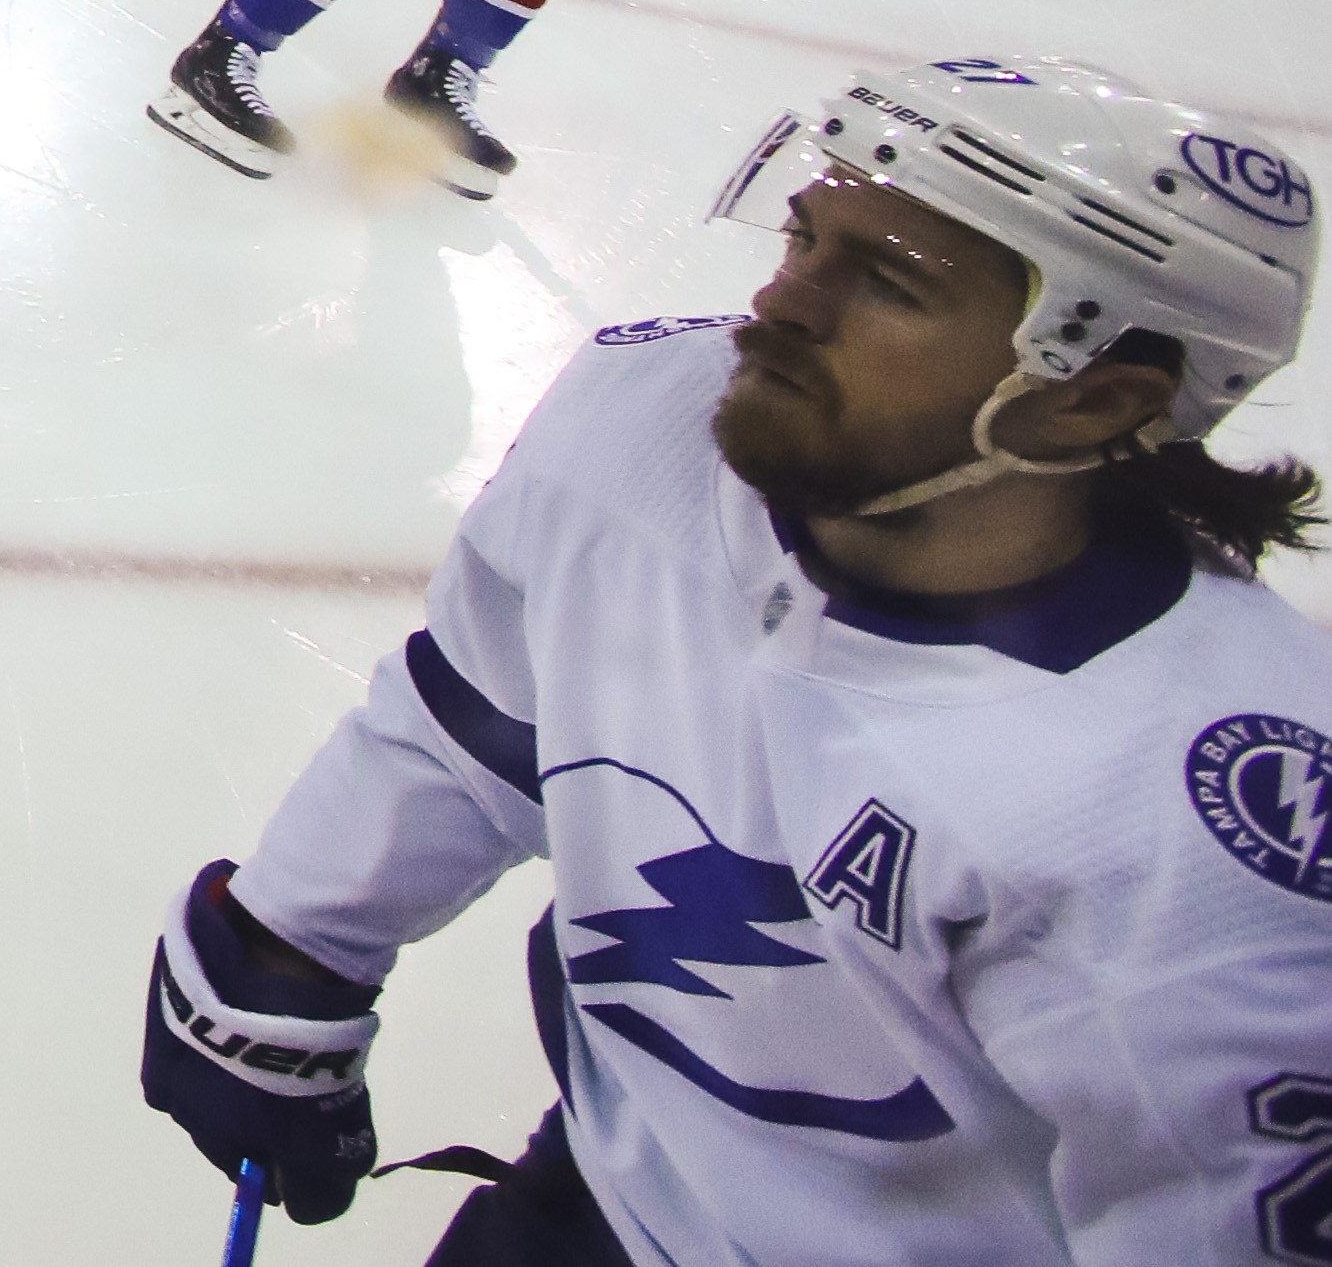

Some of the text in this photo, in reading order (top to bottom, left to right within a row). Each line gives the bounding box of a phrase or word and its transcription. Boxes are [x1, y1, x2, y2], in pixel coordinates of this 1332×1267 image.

[847, 86, 939, 133] BAUER
[1200, 720, 1252, 764] BAY
[1194, 769, 1271, 869] TAMPA
[804, 796, 917, 952] A
[162, 961, 361, 1080] AUER
